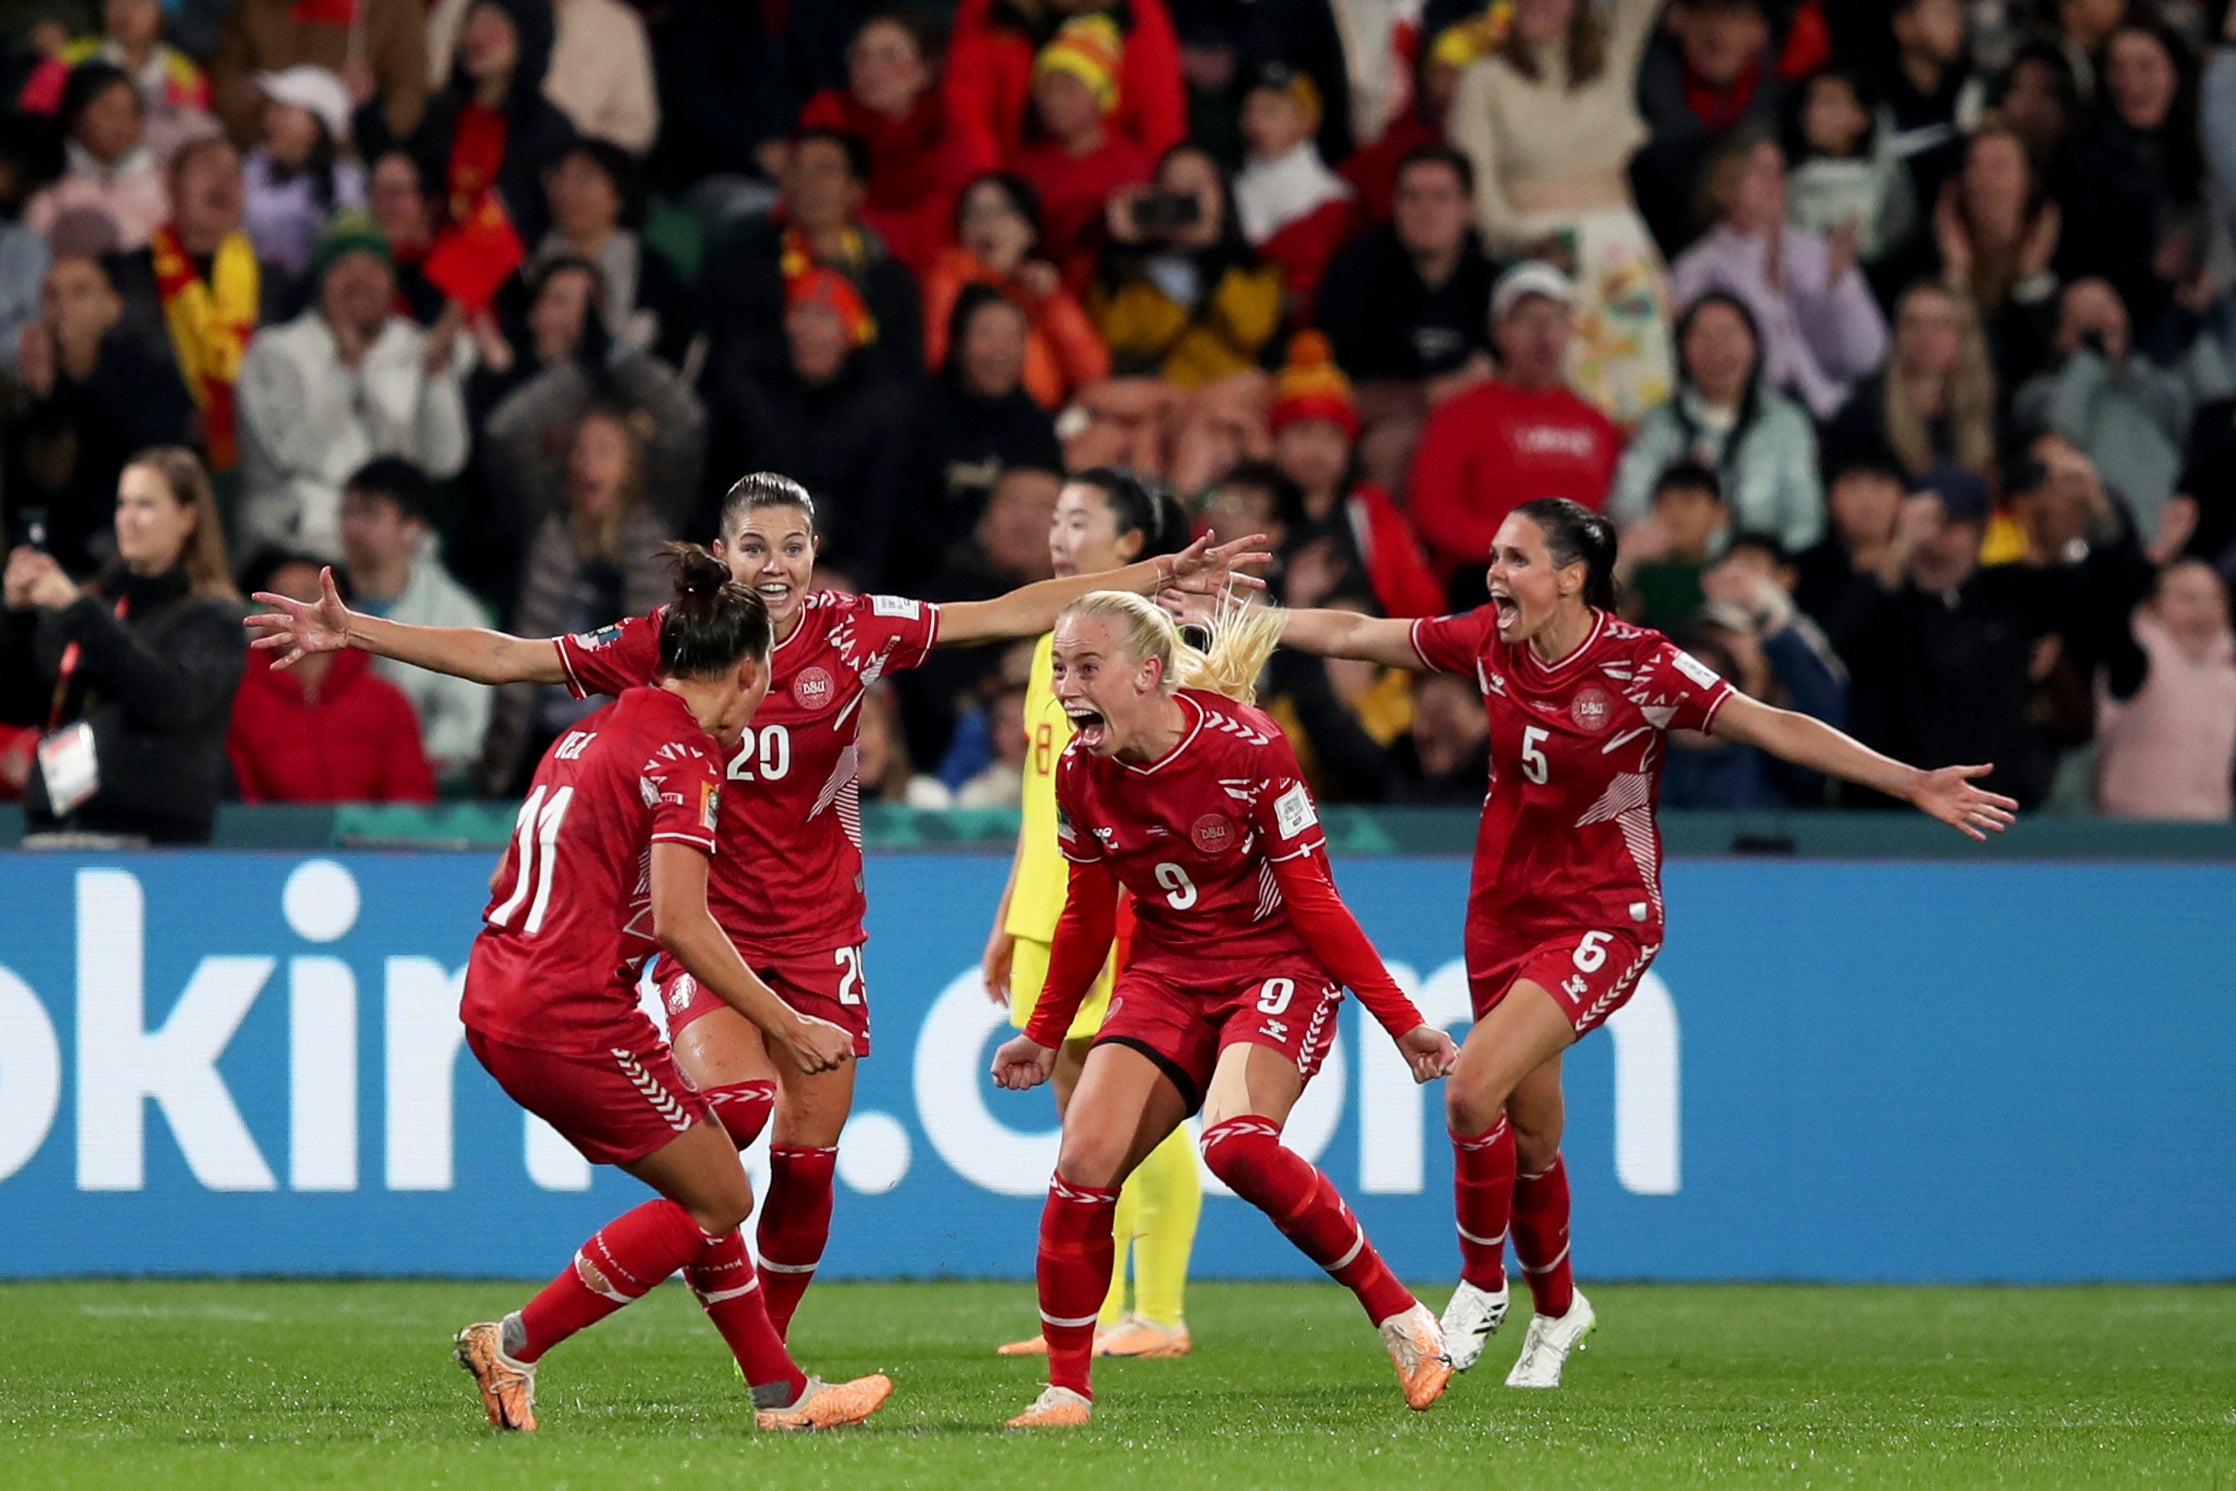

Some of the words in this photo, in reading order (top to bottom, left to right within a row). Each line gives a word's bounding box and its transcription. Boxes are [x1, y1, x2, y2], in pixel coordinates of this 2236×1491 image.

[726, 724, 791, 781] 20
[1035, 723, 1052, 776] 8
[1522, 725, 1550, 785] 5
[488, 784, 575, 934] 11
[1155, 862, 1198, 911] 9
[1257, 977, 1295, 1015] 9
